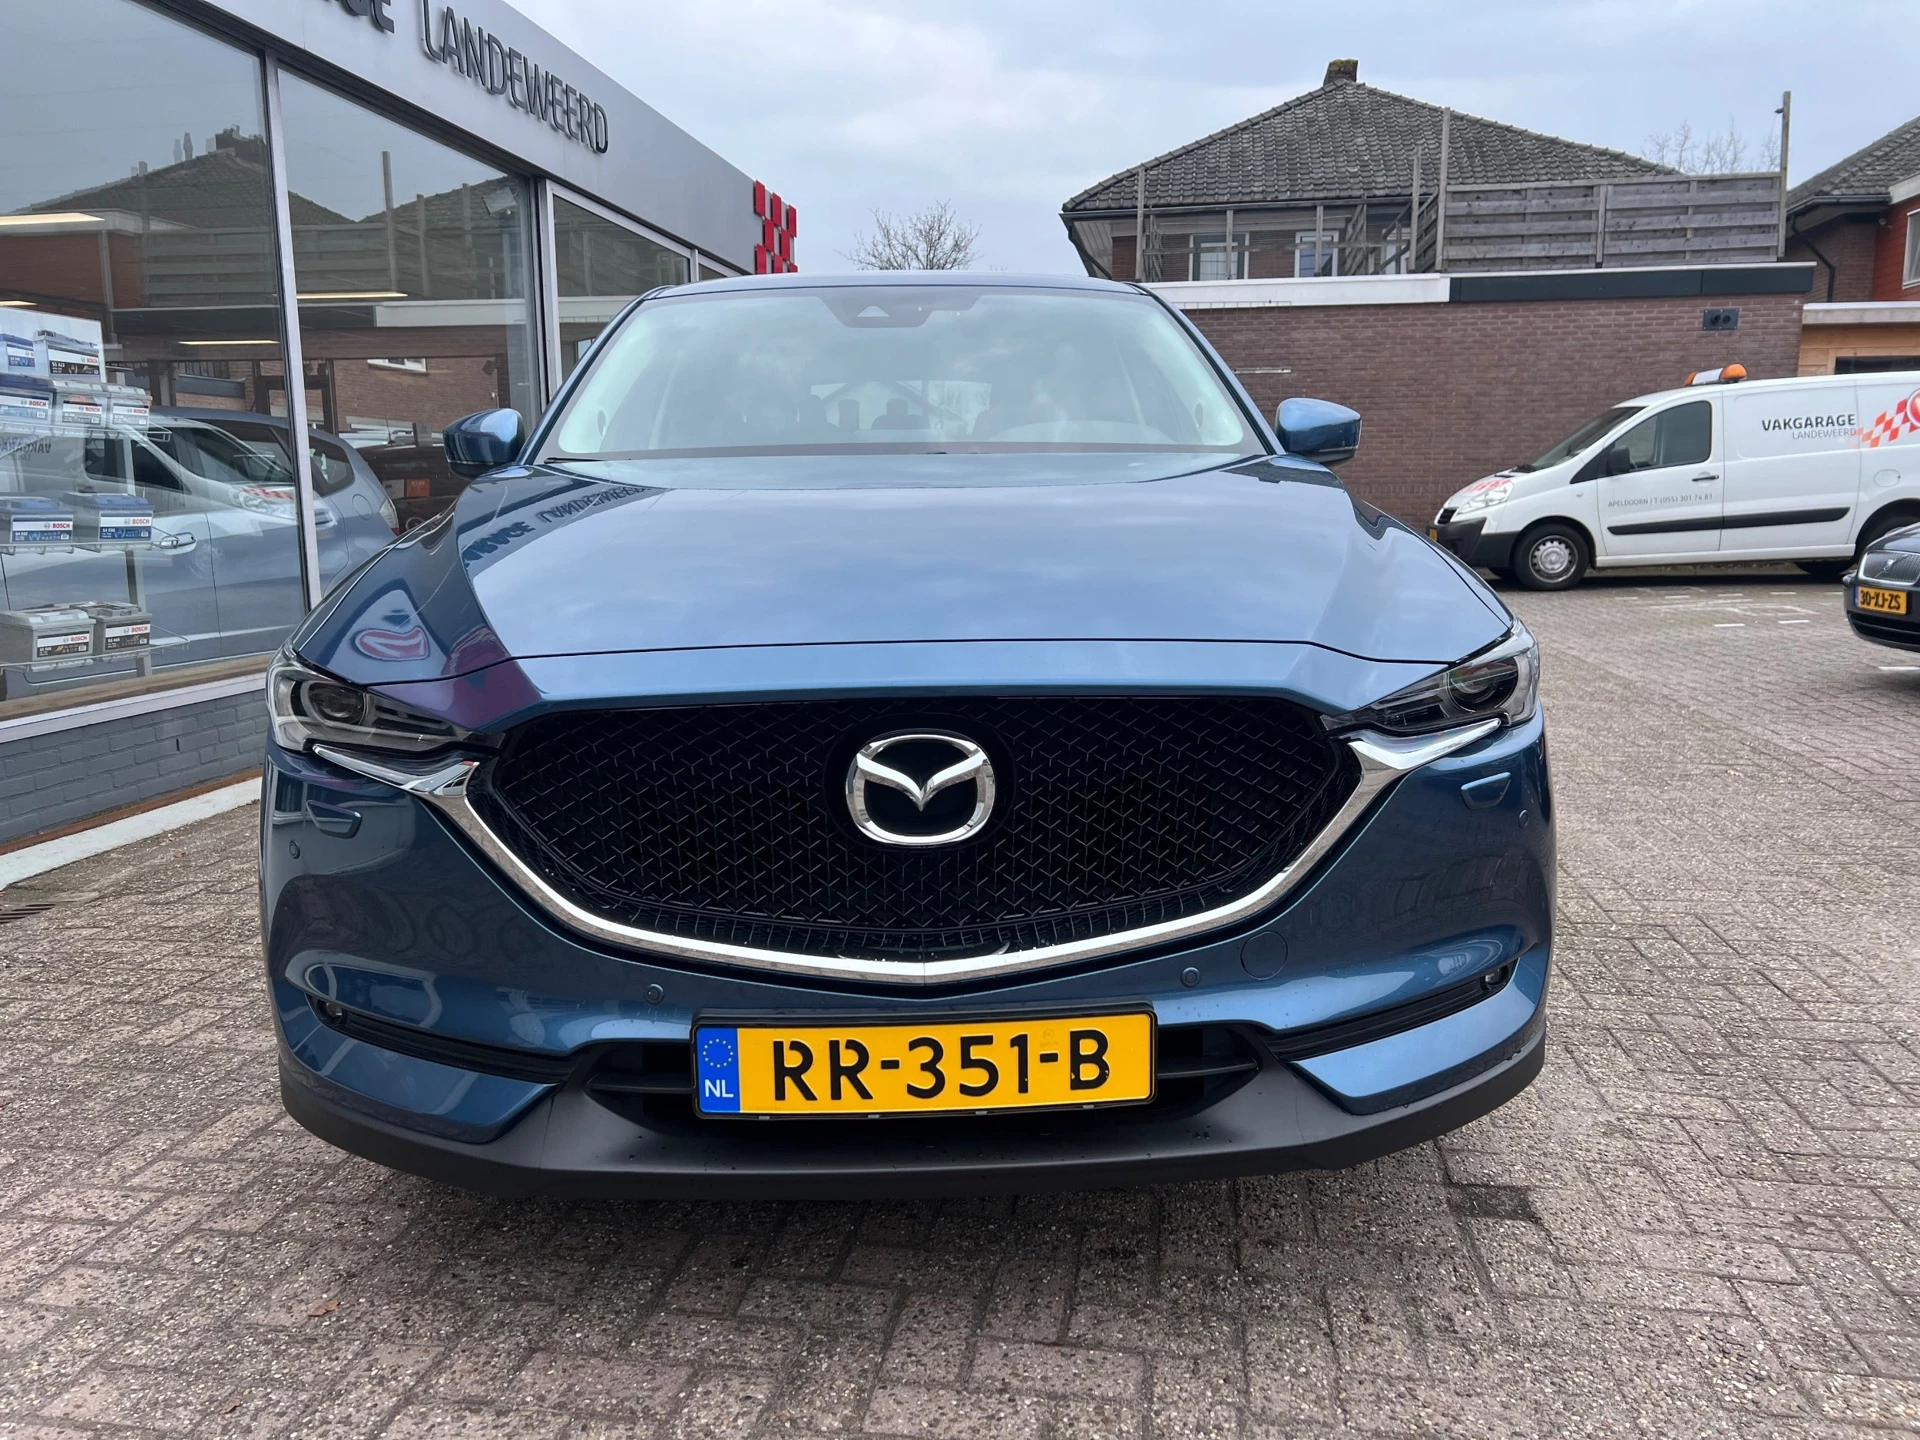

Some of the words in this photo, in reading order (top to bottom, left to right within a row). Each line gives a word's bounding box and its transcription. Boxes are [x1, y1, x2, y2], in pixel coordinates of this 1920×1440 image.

[423, 0, 609, 154] LANDEWEERD
[1762, 414, 1856, 431] VAKGARAGE
[1792, 427, 1857, 440] LANDEWEERD
[1860, 589, 1902, 610] 30-XJ-ZS
[772, 1029, 1109, 1101] RR-351-B
[704, 1079, 734, 1098] NL
